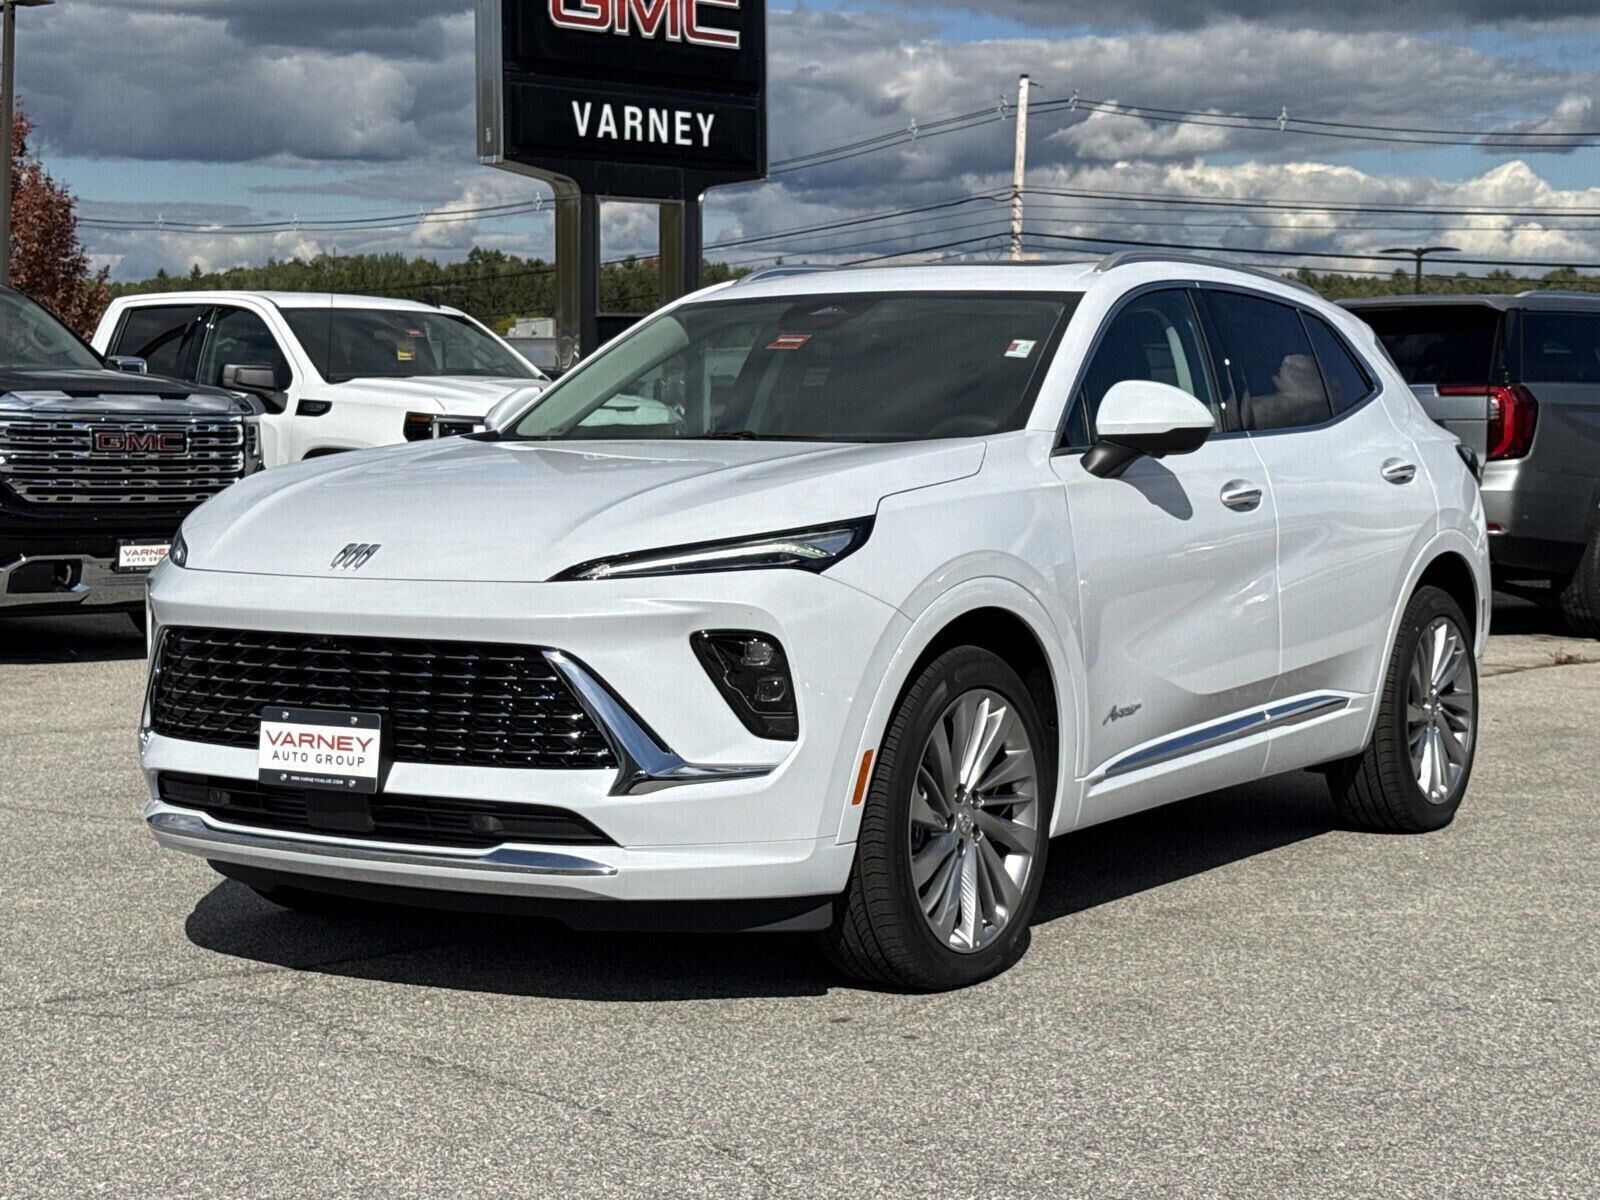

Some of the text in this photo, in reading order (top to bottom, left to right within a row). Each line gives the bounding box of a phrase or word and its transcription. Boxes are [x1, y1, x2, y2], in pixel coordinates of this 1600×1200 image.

[549, 0, 741, 50] GMC
[571, 100, 715, 148] VARNEY
[96, 432, 184, 451] GMC
[123, 548, 168, 557] VARNE
[265, 729, 374, 753] VARNEY
[272, 750, 366, 767] AUTO GROUP
